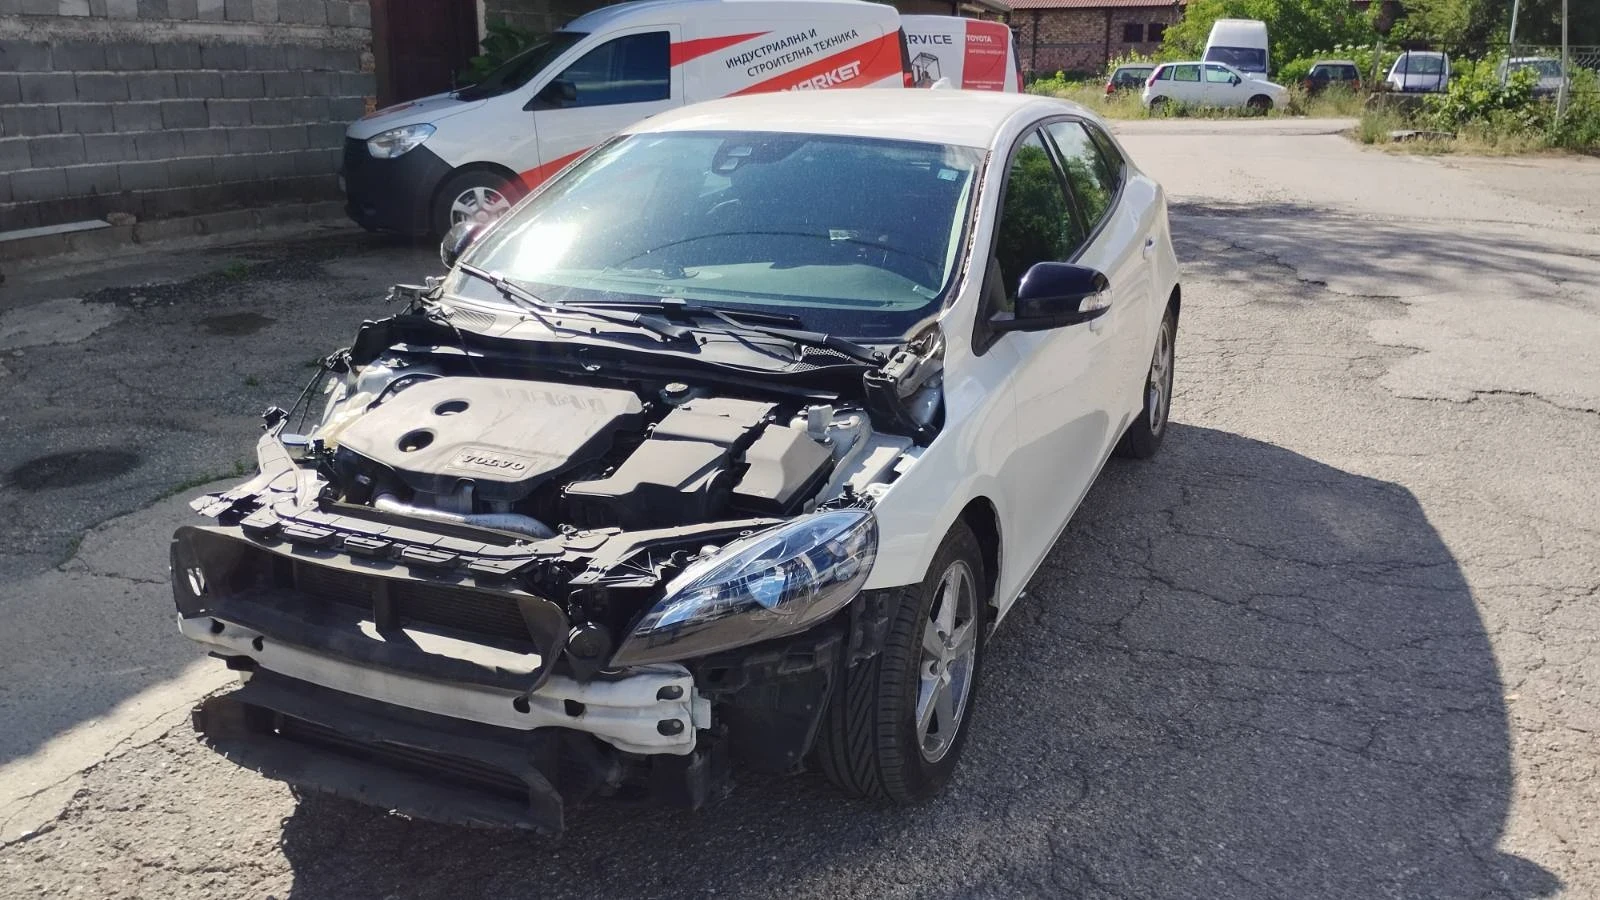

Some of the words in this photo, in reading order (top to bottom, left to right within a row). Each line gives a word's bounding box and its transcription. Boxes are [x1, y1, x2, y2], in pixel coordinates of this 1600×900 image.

[725, 32, 808, 69] ИНДУСТРИАЛНА
[808, 28, 817, 38] И
[905, 34, 953, 45] RVICE
[966, 34, 993, 44] TOYOTA
[747, 45, 814, 77] СТРОИТЕЛНА
[814, 28, 859, 52] ТЕХНИКА
[781, 60, 861, 92] ARKET
[462, 454, 526, 471] VOLVO
